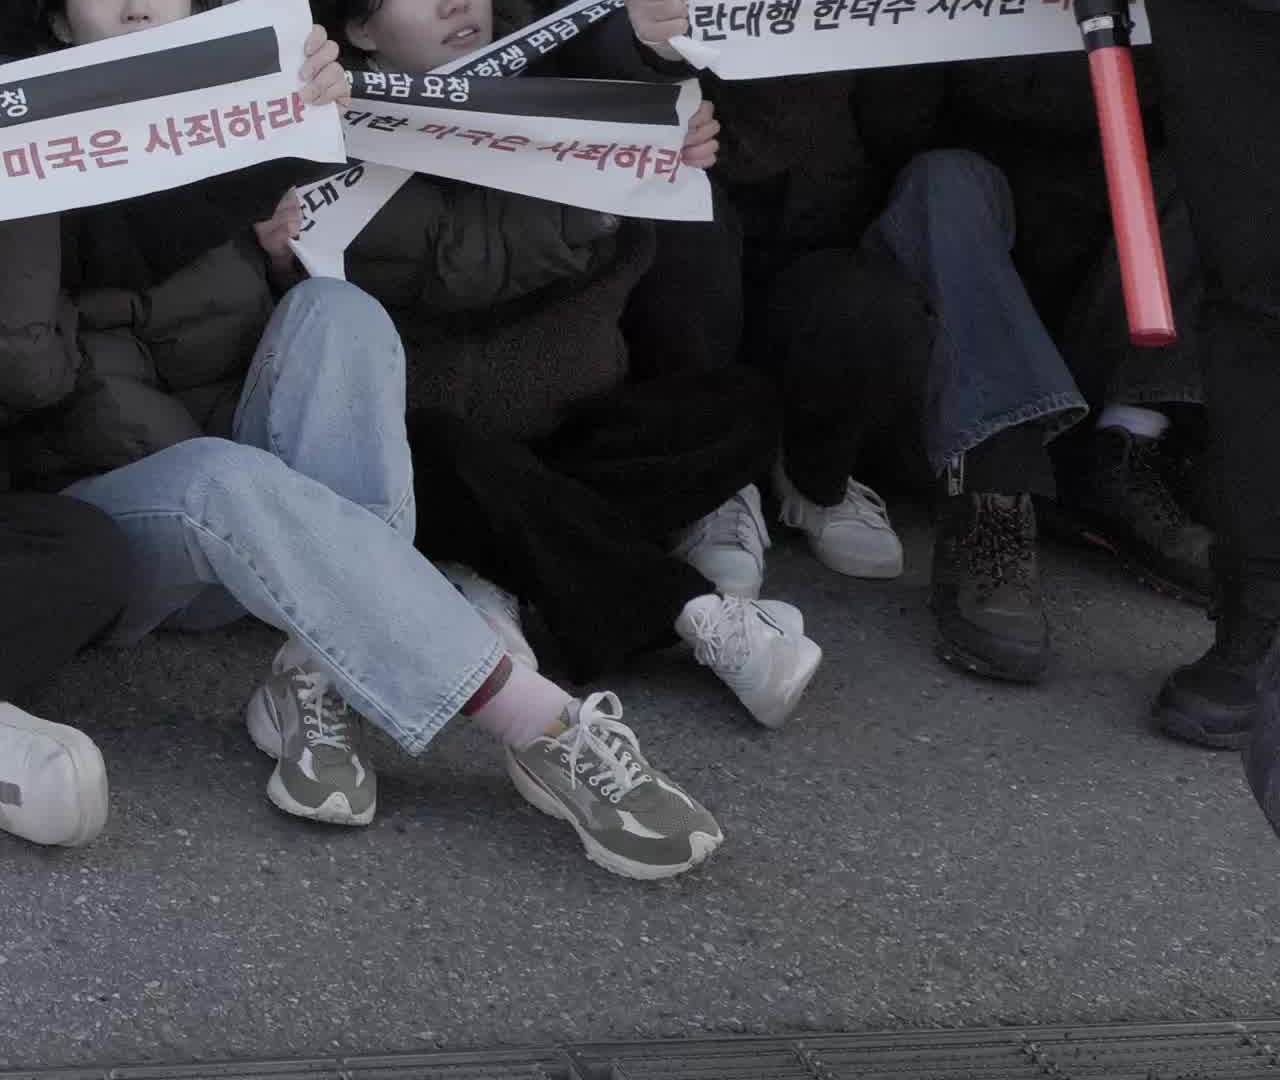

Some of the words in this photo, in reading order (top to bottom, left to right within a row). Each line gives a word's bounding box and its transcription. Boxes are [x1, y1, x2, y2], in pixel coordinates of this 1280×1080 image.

[467, 45, 529, 80] 학생
[530, 13, 580, 54] 면담
[363, 71, 414, 98] 면담
[420, 76, 470, 103] 요청
[1, 129, 129, 180] 미국은
[144, 91, 305, 157] 사죄하라
